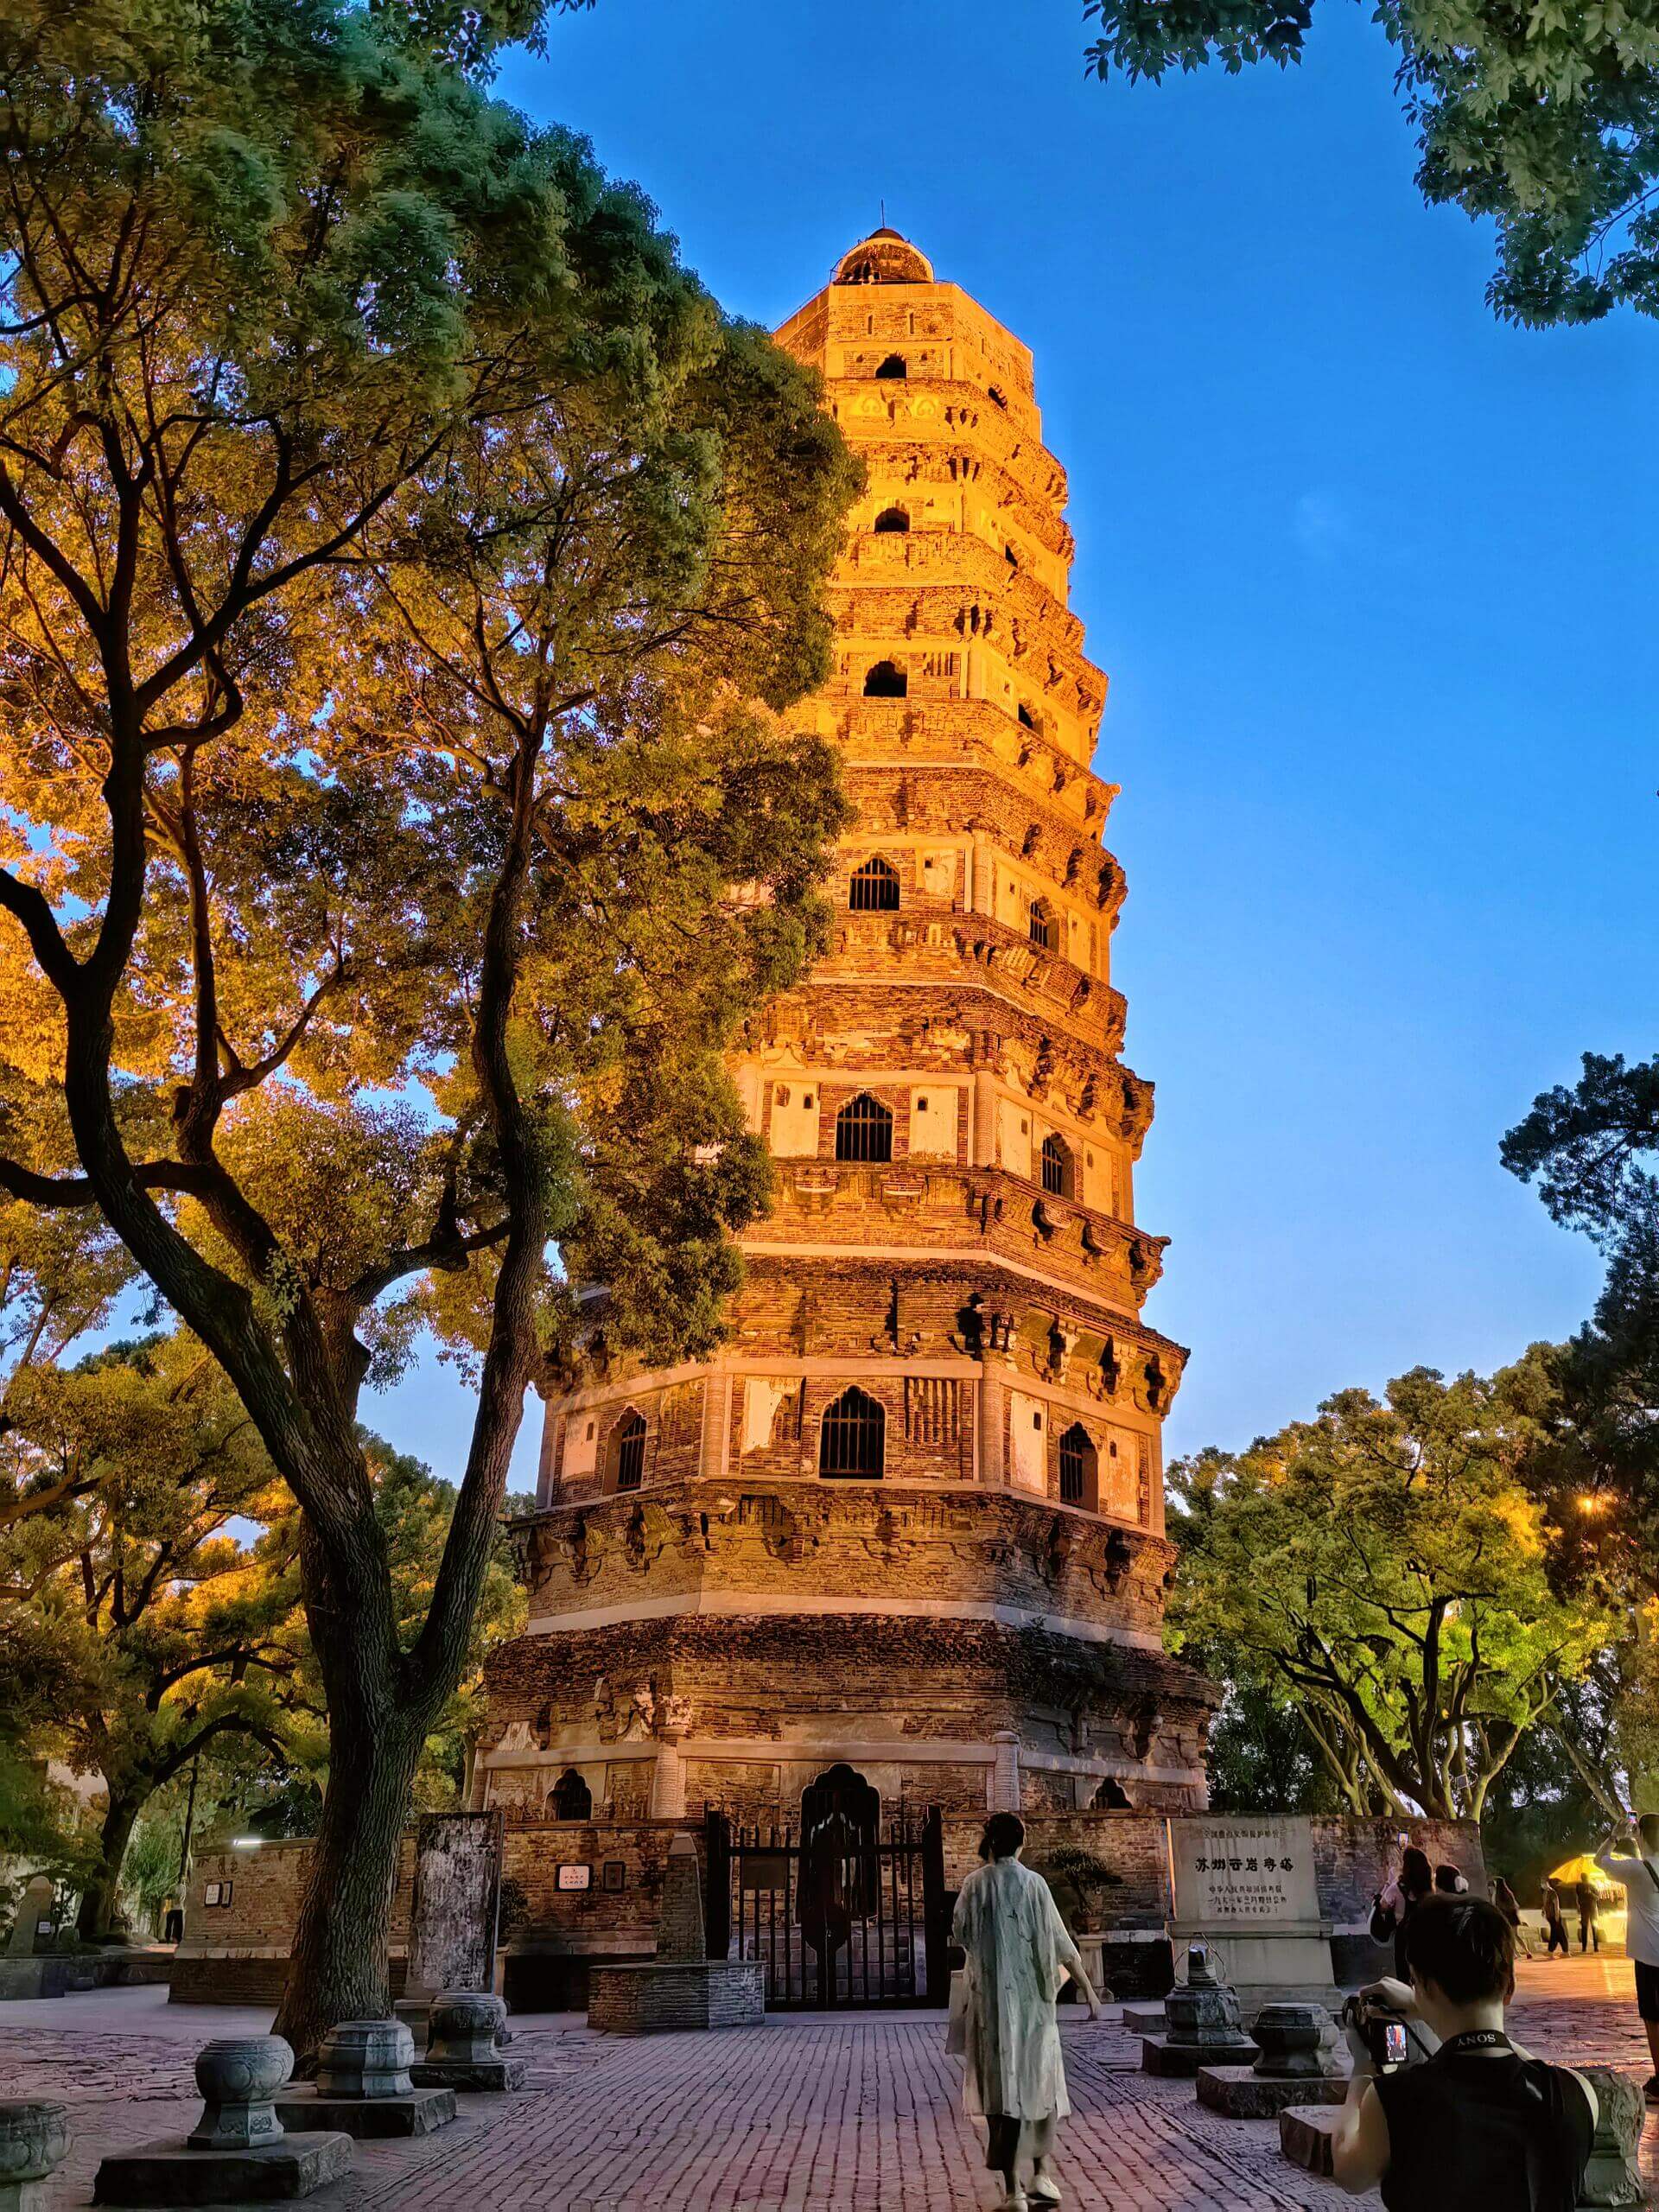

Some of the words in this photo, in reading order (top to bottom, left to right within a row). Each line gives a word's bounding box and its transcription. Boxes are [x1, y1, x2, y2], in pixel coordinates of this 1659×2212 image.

[1195, 1857, 1294, 1872] 苏州云岩寺塔
[1457, 2033, 1497, 2046] SONY
